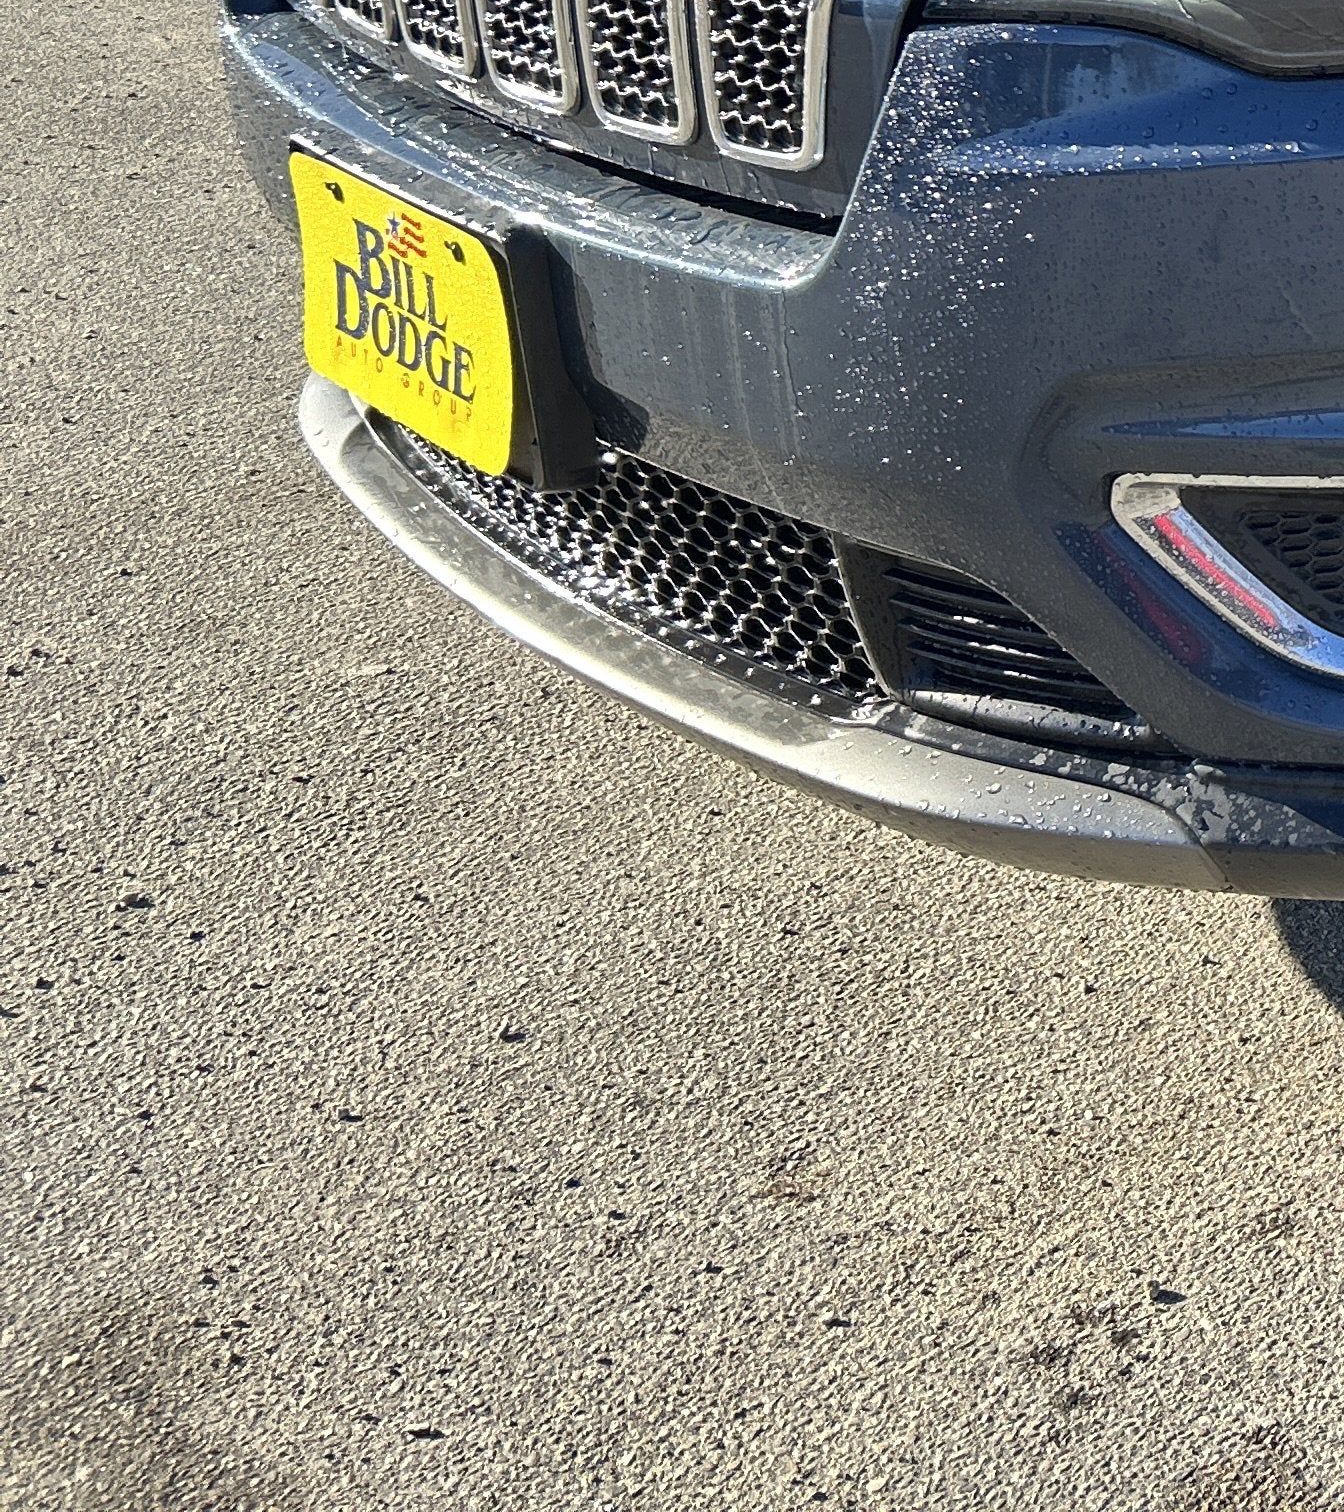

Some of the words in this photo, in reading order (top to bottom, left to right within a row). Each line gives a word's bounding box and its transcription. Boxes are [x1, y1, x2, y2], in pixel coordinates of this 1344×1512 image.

[333, 258, 477, 404] DODGE
[352, 217, 448, 332] BILL
[335, 334, 384, 373] AUTO
[401, 372, 472, 422] GROUP
